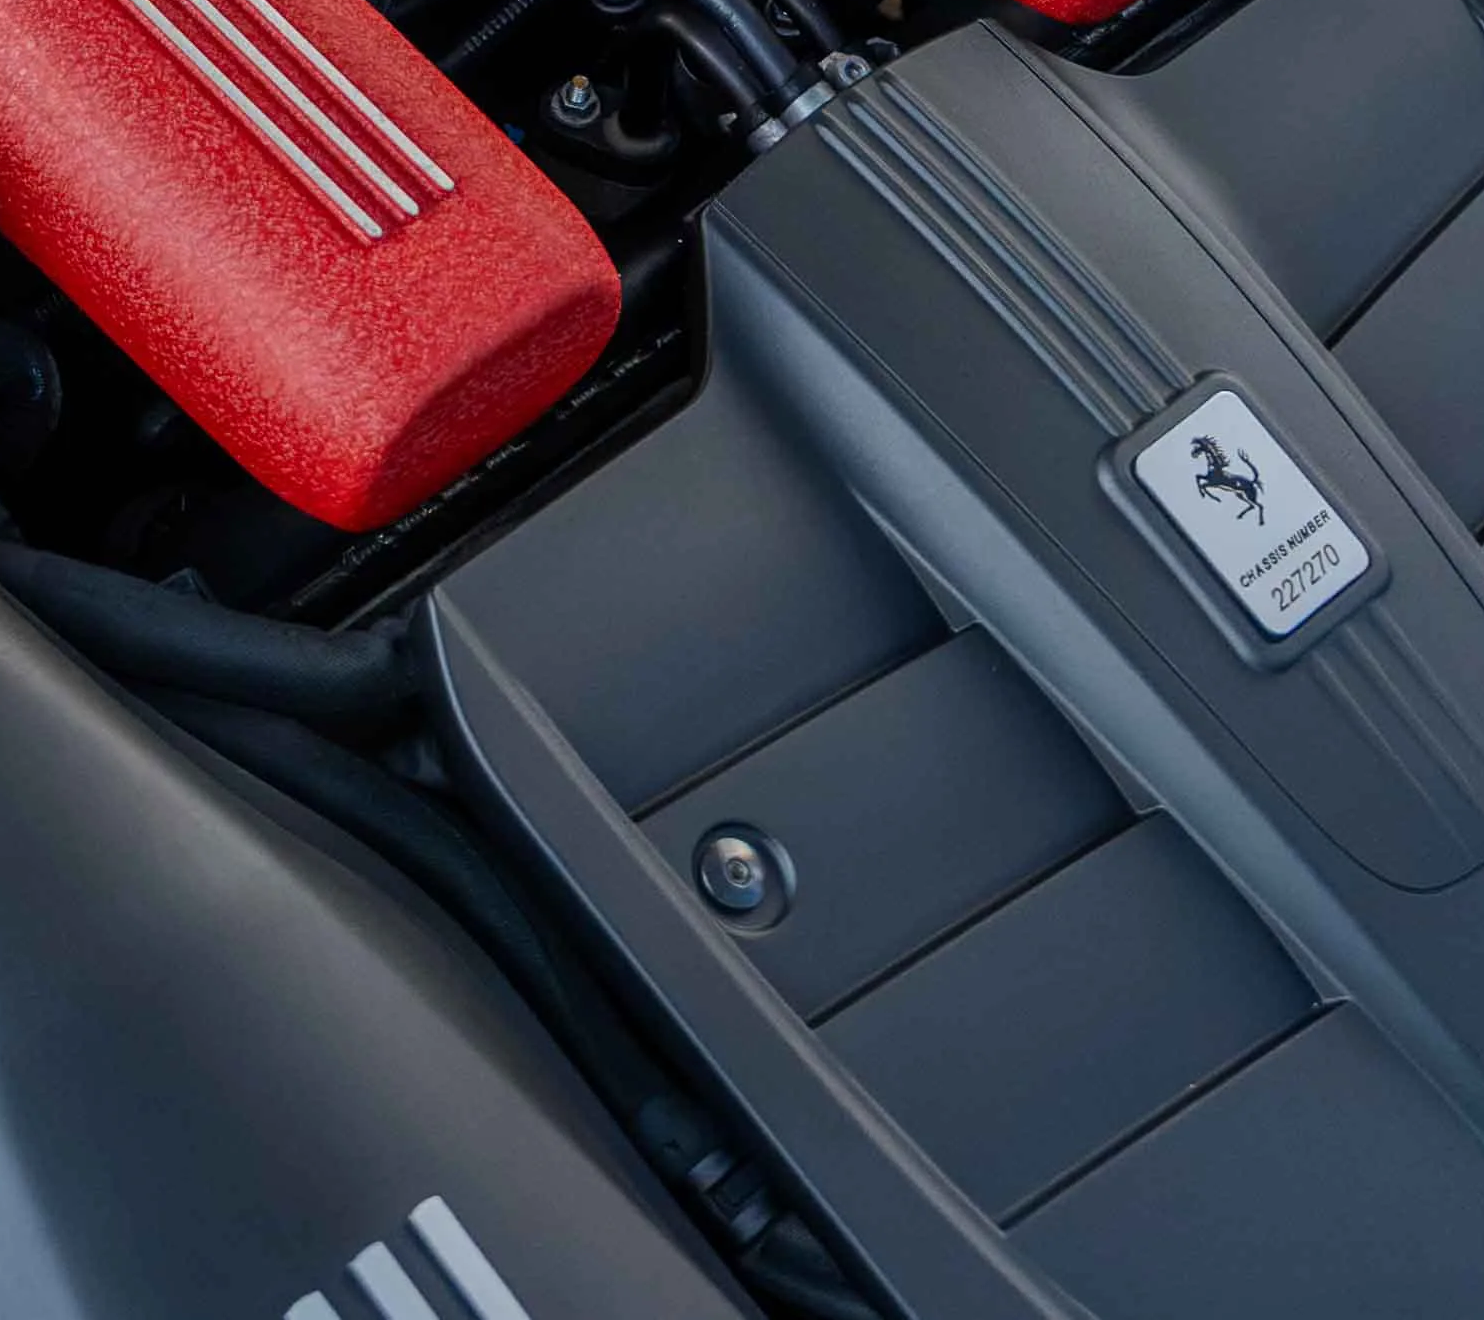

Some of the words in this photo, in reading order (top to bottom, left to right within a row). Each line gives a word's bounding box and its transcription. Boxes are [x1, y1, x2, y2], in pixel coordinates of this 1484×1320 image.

[1239, 544, 1288, 588] CHASSIS
[1286, 509, 1331, 550] NUMBER
[1271, 543, 1341, 612] 227270
